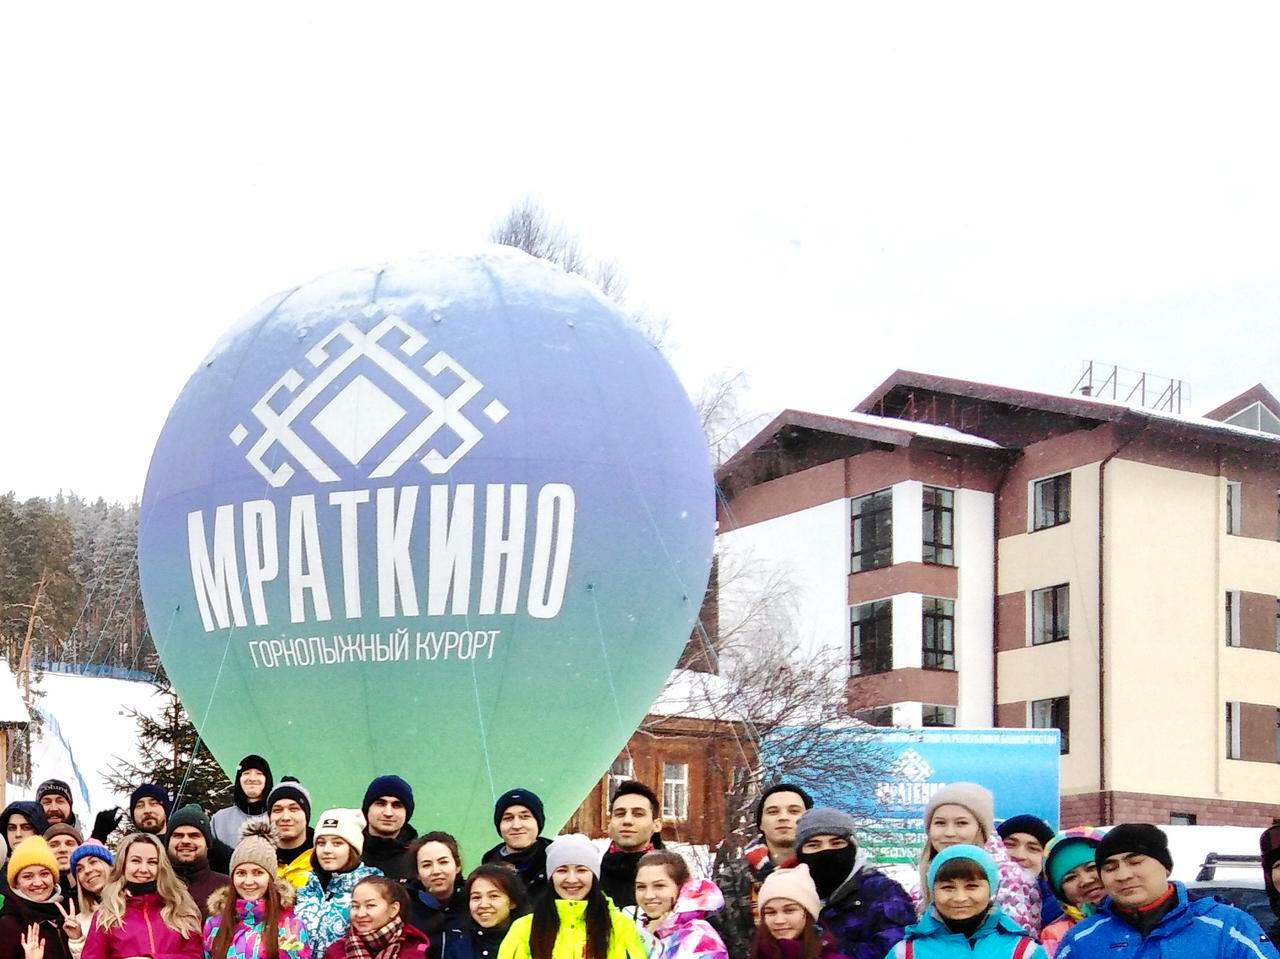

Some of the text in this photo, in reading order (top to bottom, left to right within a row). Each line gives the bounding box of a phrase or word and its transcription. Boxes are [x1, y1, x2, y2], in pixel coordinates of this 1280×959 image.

[187, 483, 576, 632] МРАТКИНО
[248, 628, 501, 668] ГОРНОЛЫЖНЫЙ КУРОРТ
